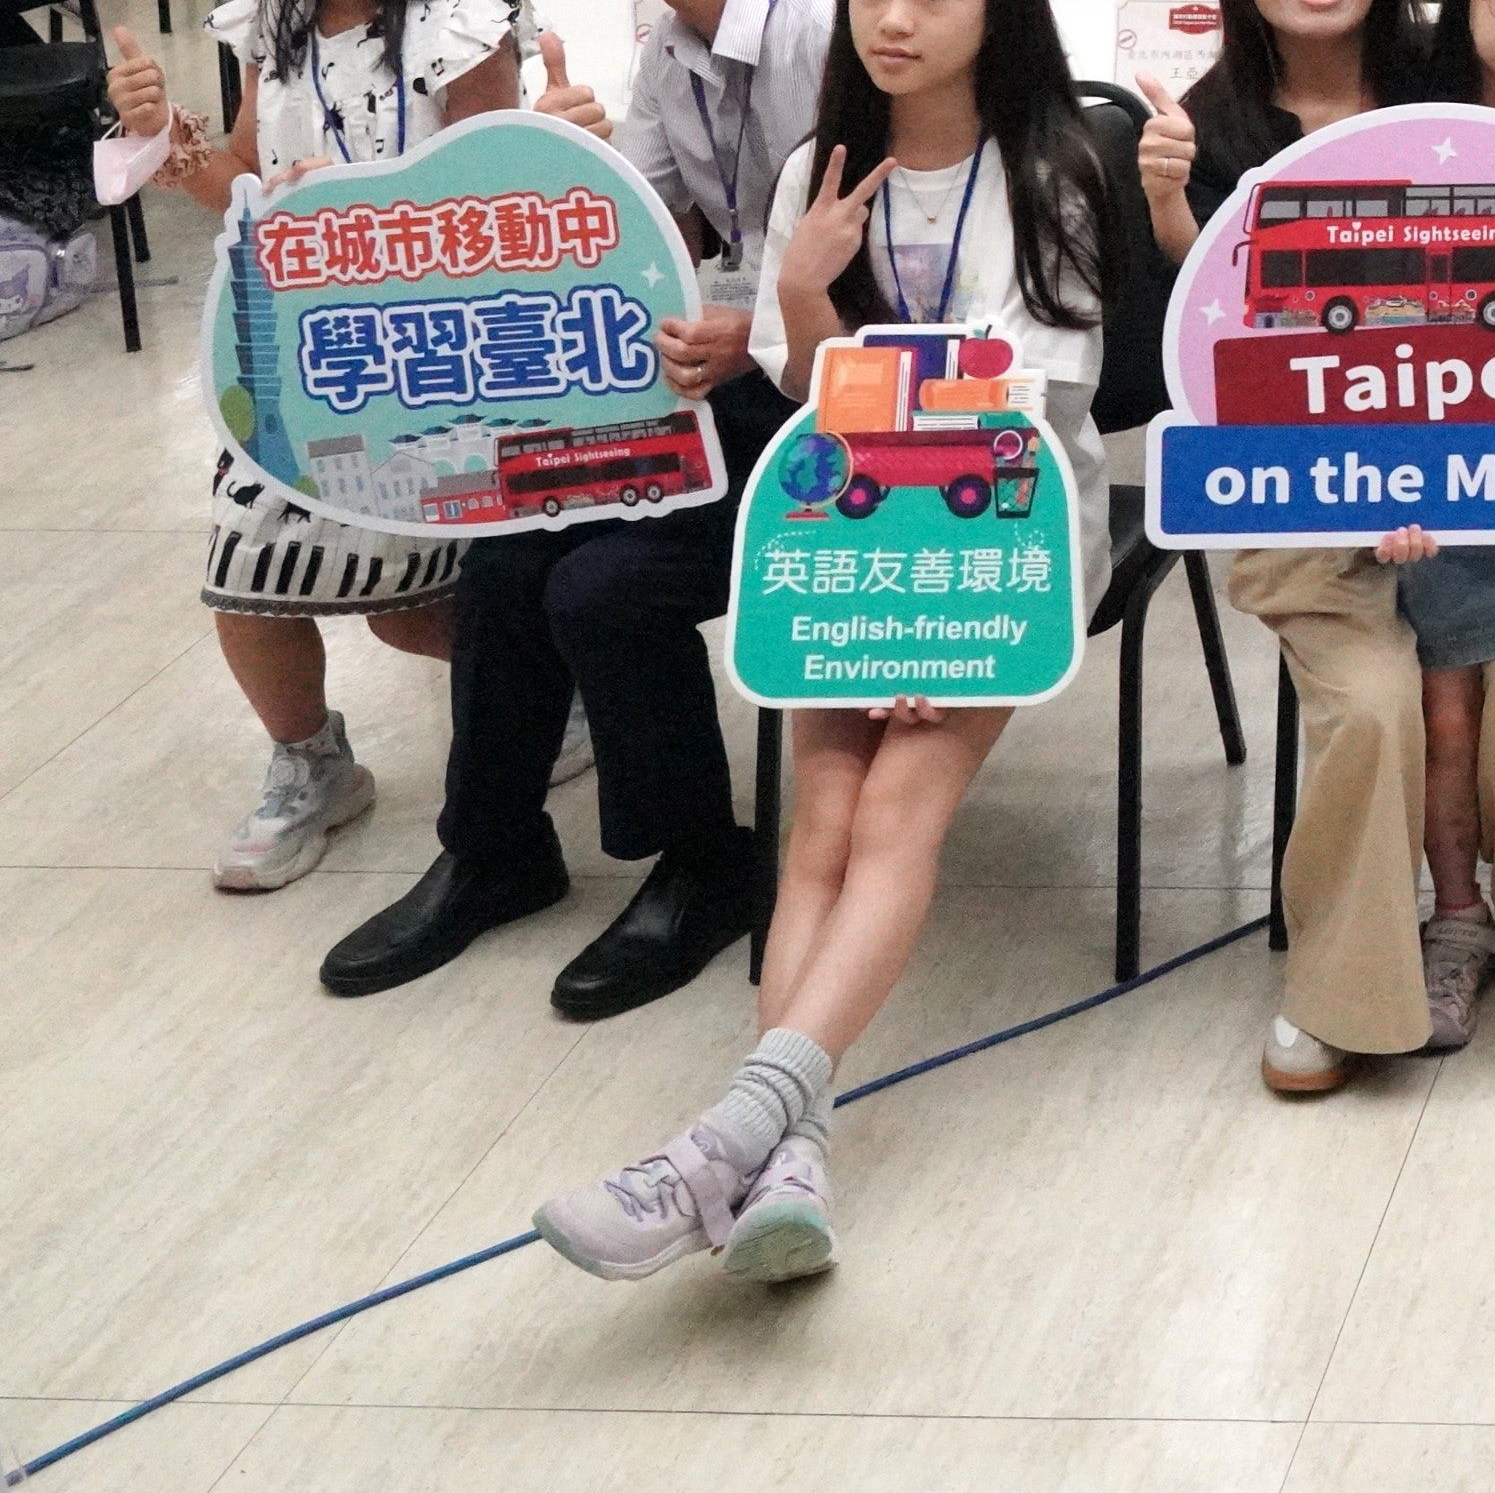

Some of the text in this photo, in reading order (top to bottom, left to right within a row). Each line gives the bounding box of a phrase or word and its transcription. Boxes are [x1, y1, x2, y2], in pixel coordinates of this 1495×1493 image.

[261, 192, 617, 283] 在城市移動中
[1326, 220, 1395, 246] Taipei
[306, 292, 654, 409] 學習臺北
[535, 445, 632, 469] Taipei Sightseeing
[1205, 464, 1291, 505] on
[1309, 451, 1426, 504] the
[762, 546, 1052, 596] 英語友善環境
[791, 613, 1028, 647] English-friendly
[803, 654, 997, 681] Environment
